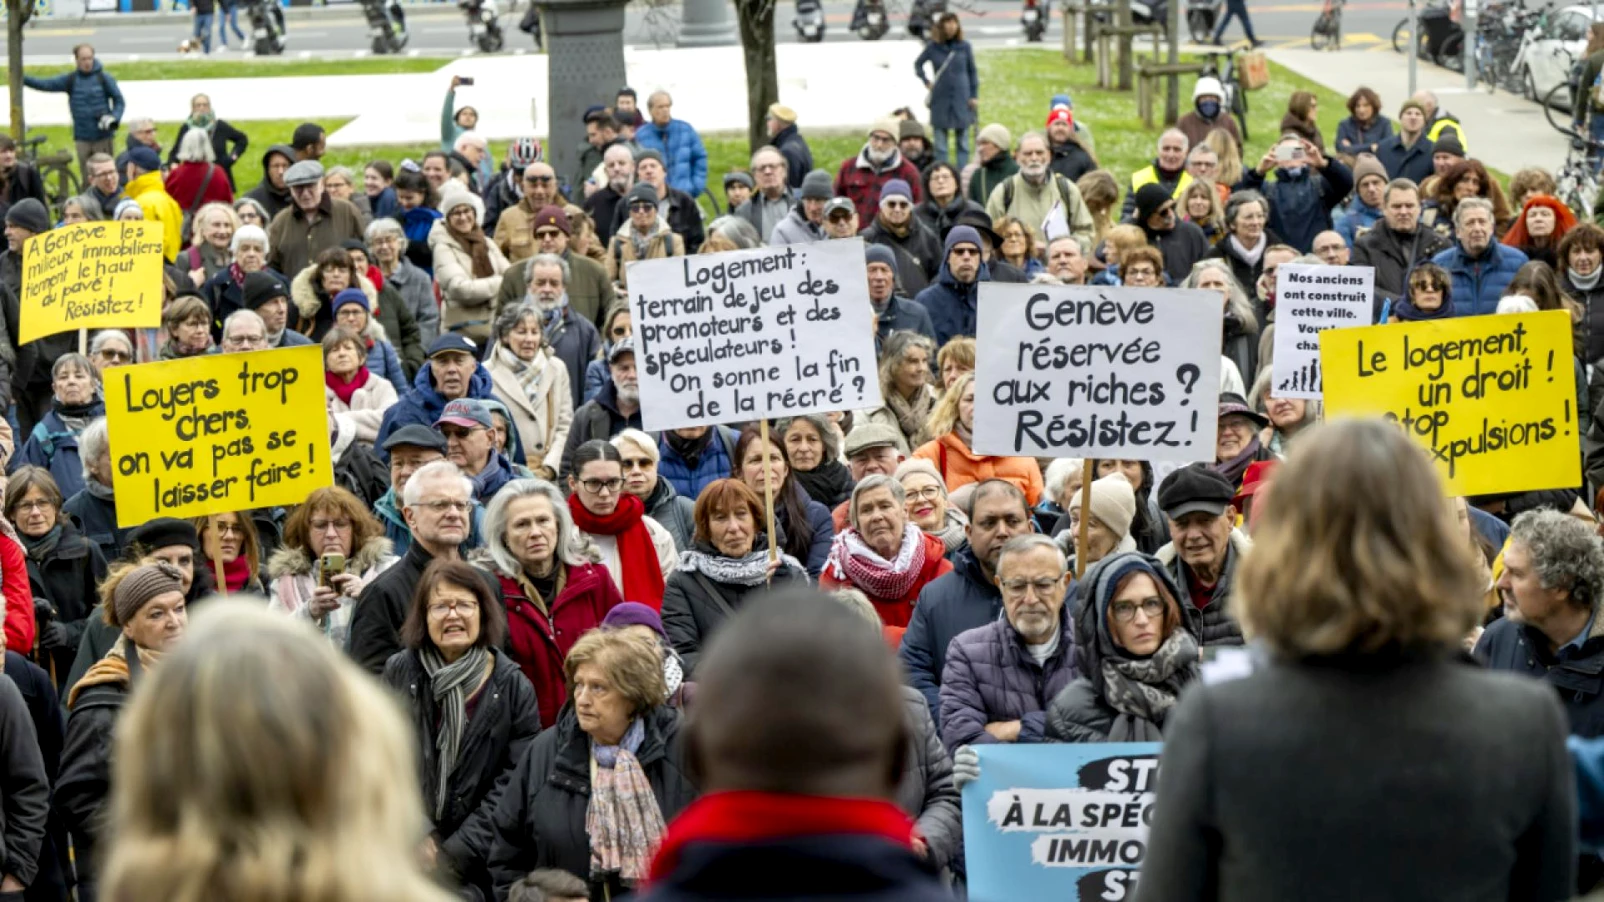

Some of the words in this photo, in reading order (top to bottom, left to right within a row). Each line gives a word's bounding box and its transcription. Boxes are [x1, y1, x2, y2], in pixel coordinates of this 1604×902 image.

[27, 238, 40, 259] A
[120, 222, 144, 240] les
[28, 250, 73, 280] milieux
[82, 239, 162, 259] immobiliers
[78, 262, 90, 279] le
[96, 259, 134, 277] haut
[60, 277, 102, 308] pavé
[636, 290, 713, 321] terrain
[723, 282, 748, 308] de
[749, 284, 785, 314] jeu
[796, 270, 839, 295] des
[1284, 291, 1305, 300] ont
[1308, 292, 1366, 303] construit
[1289, 273, 1313, 283] Nos
[1315, 274, 1363, 285] anciens
[65, 294, 135, 321] Résistez
[1025, 292, 1154, 331] Genève
[1291, 308, 1324, 317] cette
[1326, 308, 1357, 319] ville.
[640, 315, 763, 355] promoteurs
[776, 304, 796, 326] et
[805, 299, 841, 322] des
[1297, 324, 1329, 334] Vou
[645, 337, 783, 381] spéculateurs
[1017, 337, 1161, 372] réservée
[1296, 341, 1321, 350] cha
[1357, 340, 1387, 377] Le
[1403, 322, 1528, 380] logement,
[712, 365, 780, 389] sonne
[795, 355, 819, 381] la
[826, 349, 860, 388] fin
[1418, 382, 1451, 408] un
[1461, 357, 1533, 400] droit
[125, 373, 220, 420] Loyers
[238, 361, 299, 405] trop
[686, 390, 720, 419] de
[734, 388, 755, 414] la
[767, 383, 844, 411] récré
[992, 378, 1051, 406] aux
[1067, 372, 1166, 407] riches
[118, 451, 150, 476] on
[160, 448, 193, 471] va
[212, 436, 254, 478] pas
[266, 429, 297, 451] se
[1429, 417, 1557, 479] xpulsions
[154, 475, 238, 513] laisser
[245, 458, 302, 502] faire
[1104, 758, 1161, 791] ST
[1001, 795, 1024, 827] À
[1032, 803, 1072, 827] LA
[1047, 839, 1145, 864] IMMO
